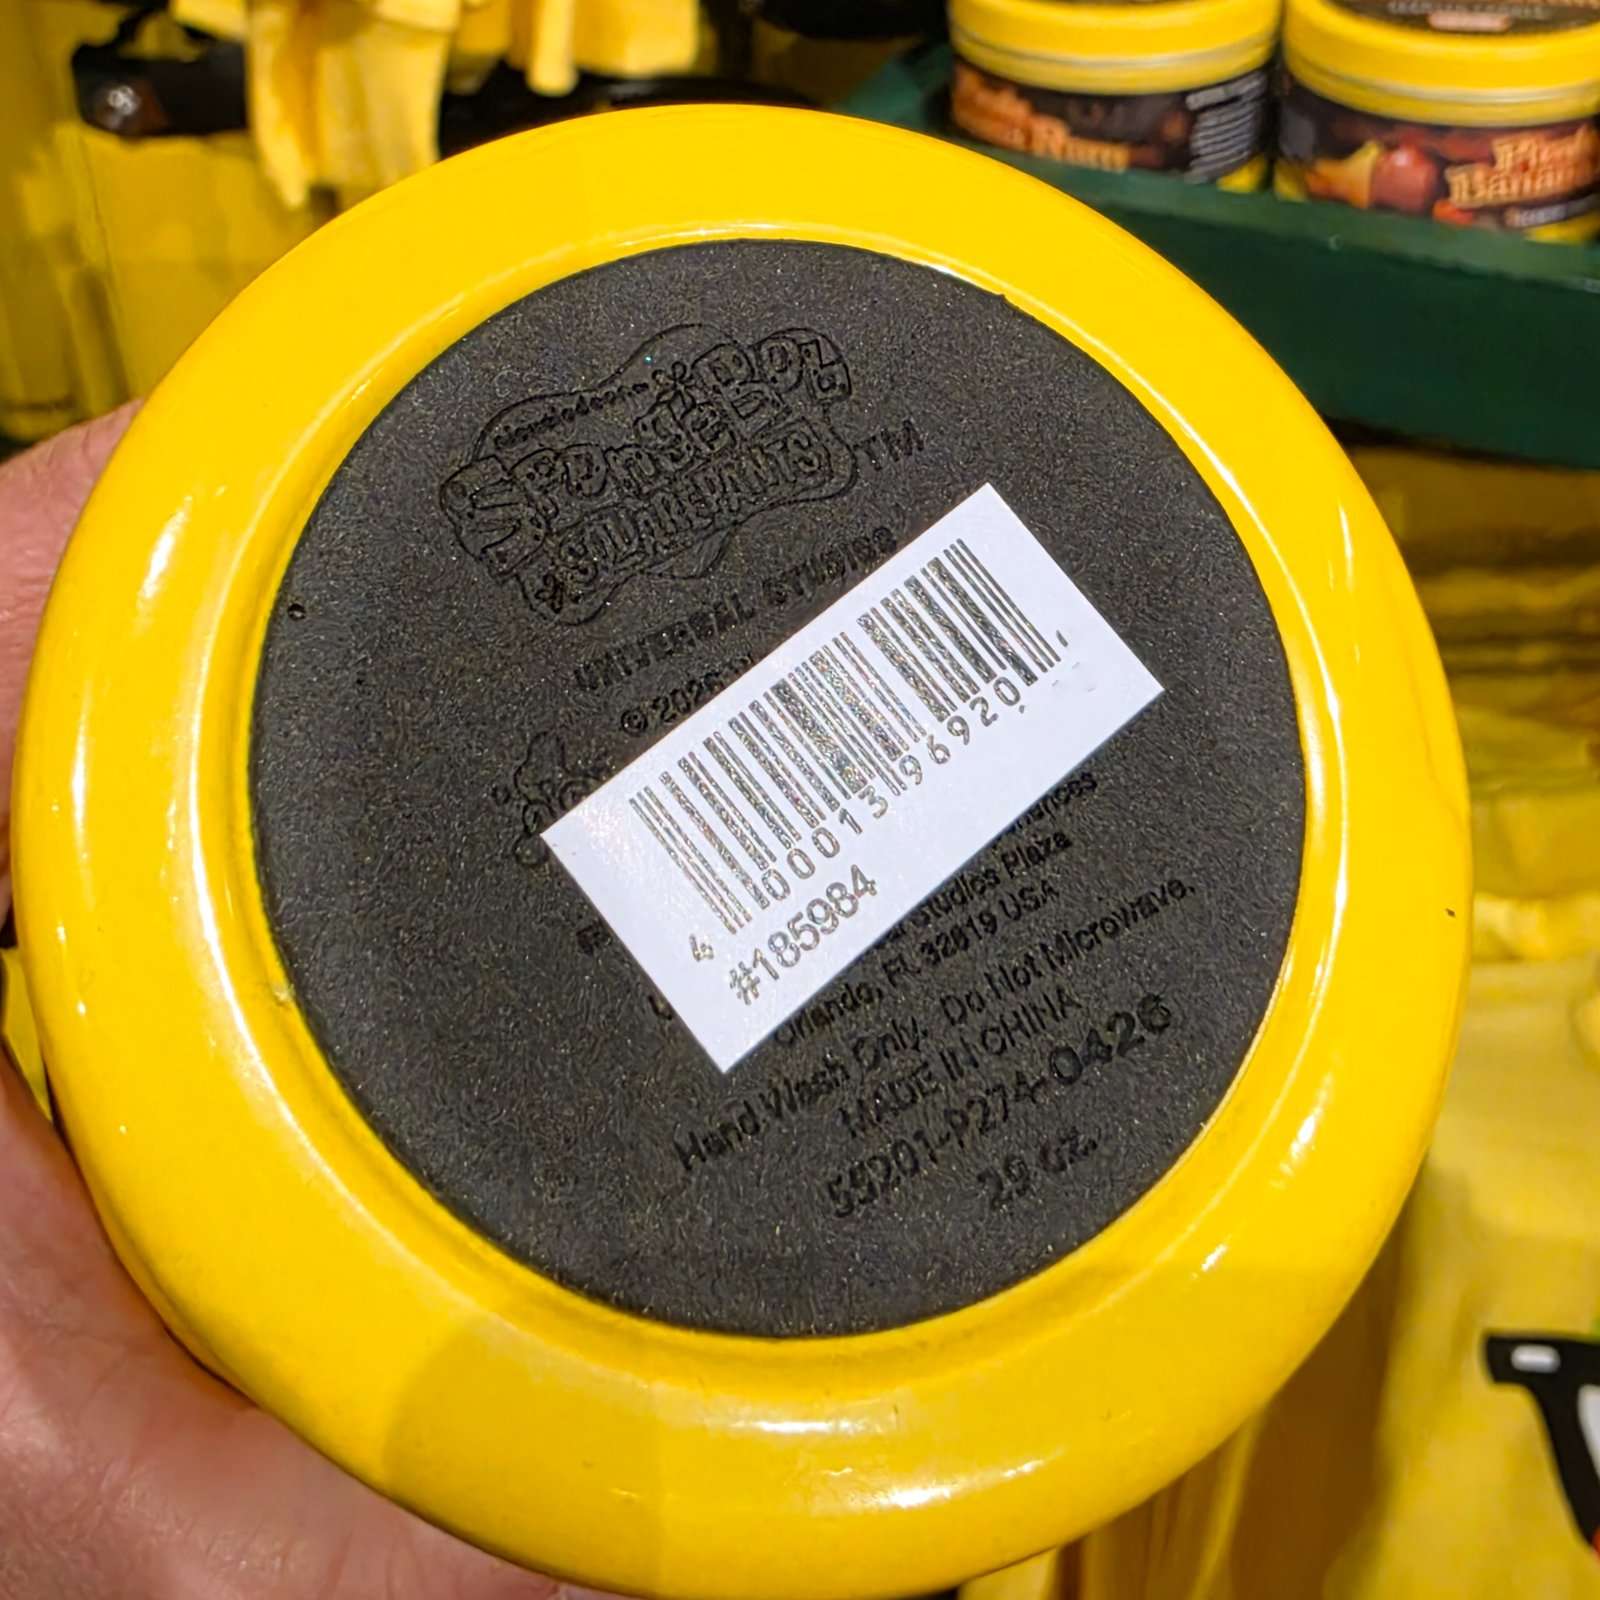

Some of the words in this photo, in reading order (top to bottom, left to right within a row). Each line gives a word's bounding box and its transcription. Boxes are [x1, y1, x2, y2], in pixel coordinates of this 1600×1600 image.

[573, 592, 754, 690] UNIVERSAL
[1001, 832, 1072, 879] Plaza
[730, 863, 877, 1005] #185984
[920, 909, 998, 966] 32819
[1000, 879, 1060, 921] USA
[673, 1099, 761, 1172] Hand
[757, 1052, 851, 1120] Wash
[852, 1015, 929, 1070] Only.
[940, 989, 986, 1026] Do
[983, 952, 1044, 997] Not
[1038, 879, 1197, 972] Microwave.
[835, 1060, 938, 1140] MADE
[938, 1036, 980, 1081] IN
[980, 987, 1082, 1056] CHINA
